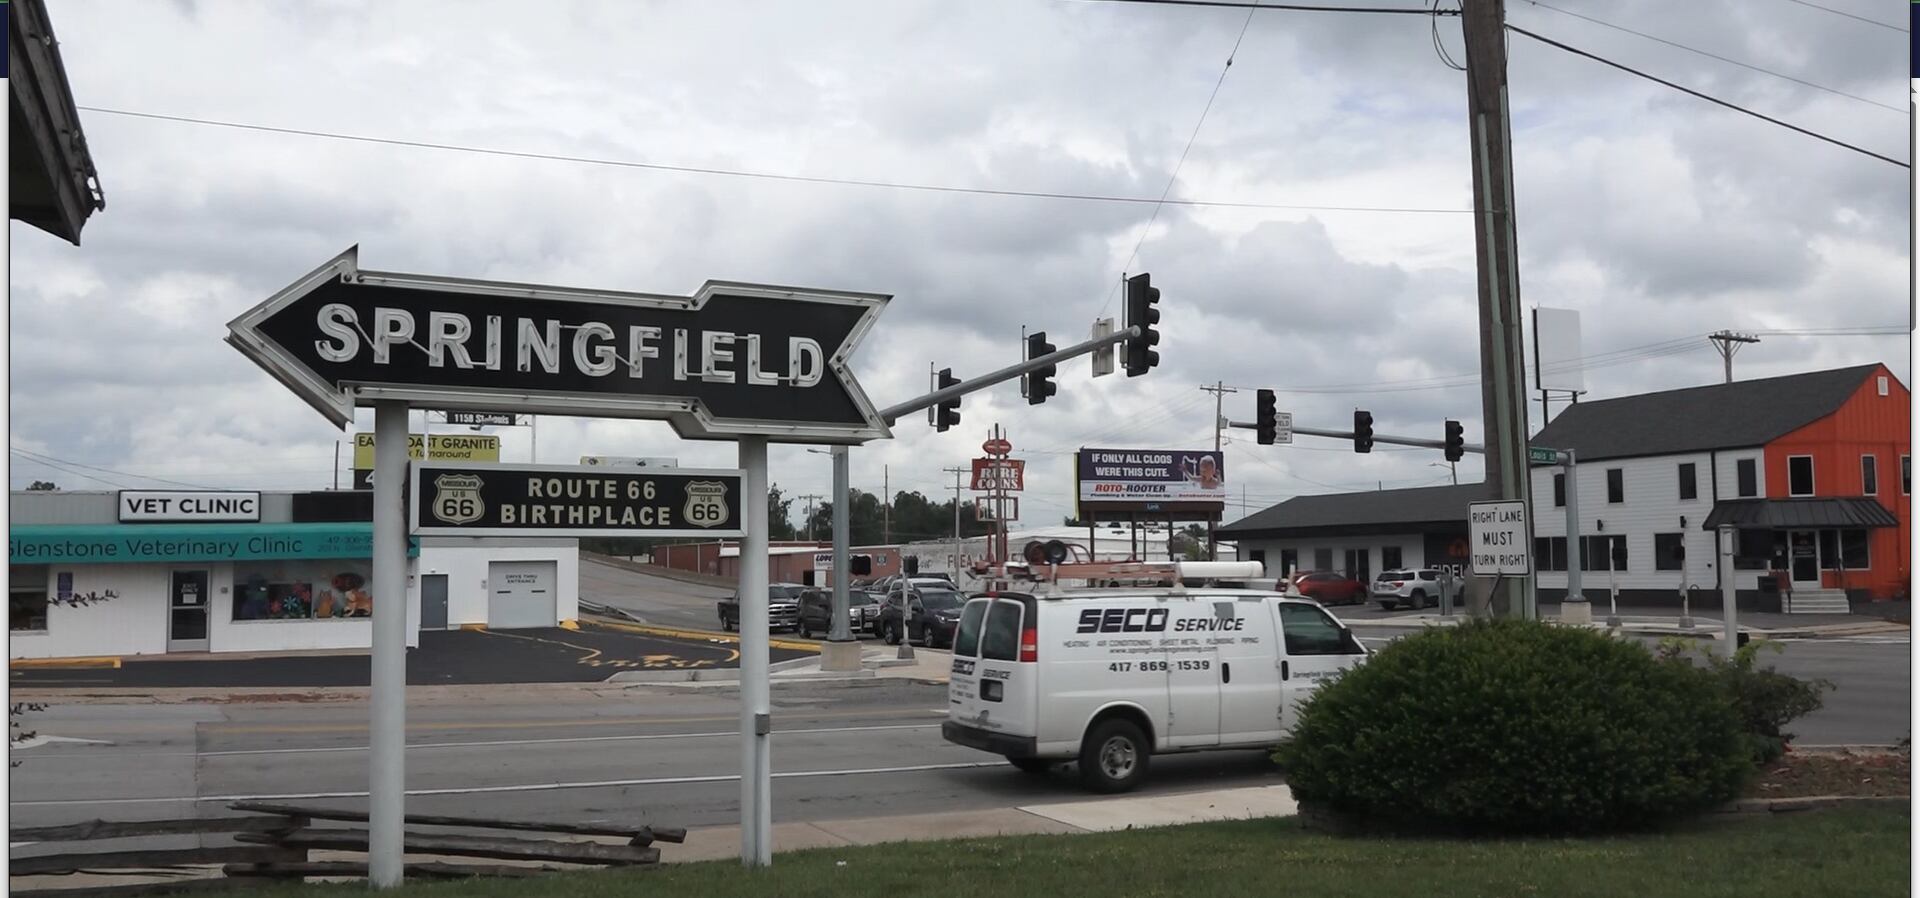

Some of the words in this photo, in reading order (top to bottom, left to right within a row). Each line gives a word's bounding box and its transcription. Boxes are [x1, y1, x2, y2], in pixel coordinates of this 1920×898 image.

[315, 303, 824, 388] SPRINGFIELD
[358, 438, 375, 447] EA
[408, 437, 437, 449] OAST
[441, 438, 496, 450] GRANITE
[415, 449, 472, 459] Tunaround
[1091, 453, 1101, 463] IF
[1101, 453, 1125, 464] ONLY
[1125, 454, 1142, 464] ALL
[1095, 466, 1122, 477] WERE
[1122, 467, 1144, 477] THIS
[1144, 467, 1171, 478] CUTE.
[528, 478, 617, 499] ROUTE
[627, 480, 656, 500] 66
[977, 478, 1018, 489] CONS
[1095, 484, 1167, 493] ROTO-ROOTER
[126, 498, 172, 514] VET
[178, 498, 254, 514] CLINIC
[442, 498, 475, 517] 66
[692, 504, 720, 520] 66
[501, 504, 671, 526] BIRTHPLACE
[1471, 511, 1497, 523] RIGHT
[1499, 510, 1523, 523] LANE
[1482, 531, 1513, 546] MUST
[126, 537, 239, 557] Veterinary
[248, 536, 303, 554] Clinic
[1474, 554, 1496, 566] TURN
[1499, 554, 1525, 566] RIGHT
[1076, 608, 1170, 633] SECO
[1174, 618, 1245, 632] SERVICE
